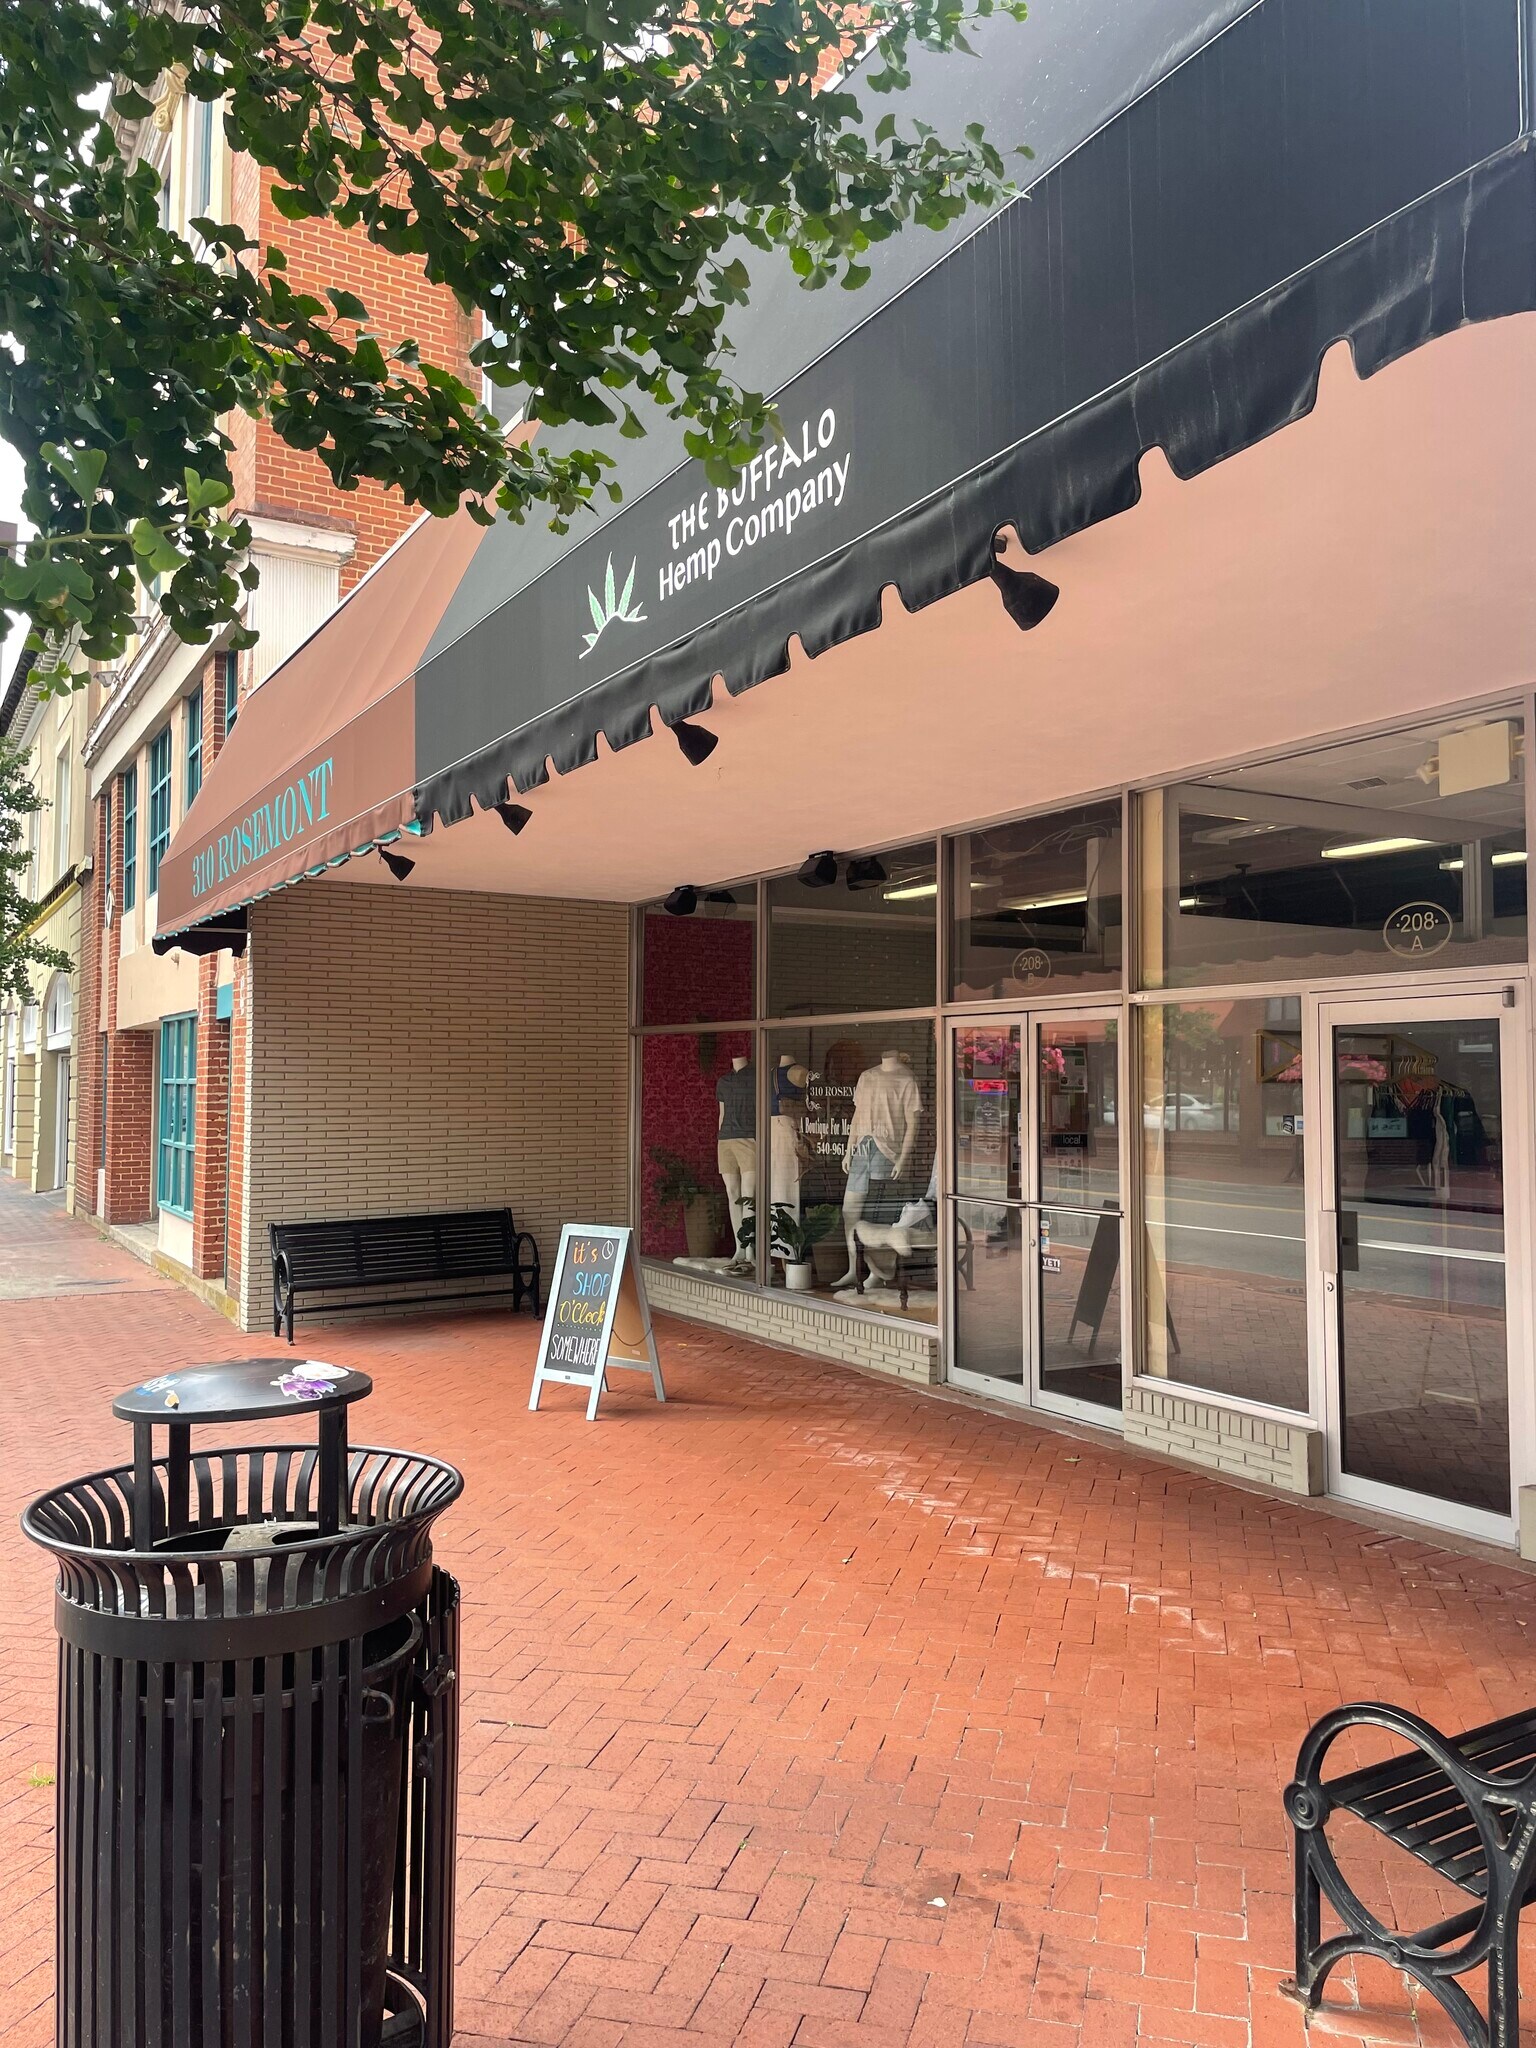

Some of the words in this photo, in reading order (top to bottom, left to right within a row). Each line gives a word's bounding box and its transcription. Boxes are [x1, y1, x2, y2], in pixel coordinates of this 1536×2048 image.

[668, 491, 709, 550] THE
[716, 408, 836, 519] BUFFALO
[659, 537, 721, 601] Hemp
[725, 452, 851, 556] Company
[192, 844, 216, 898] 310
[217, 757, 333, 883] ROSEMONT
[1401, 911, 1434, 933] 208
[1411, 935, 1424, 951] A
[1021, 955, 1041, 971] 208
[573, 1241, 599, 1265] it's
[1042, 1256, 1061, 1268] YETI
[572, 1271, 612, 1297] SHOP
[550, 1333, 601, 1366] SOMEWHERE
